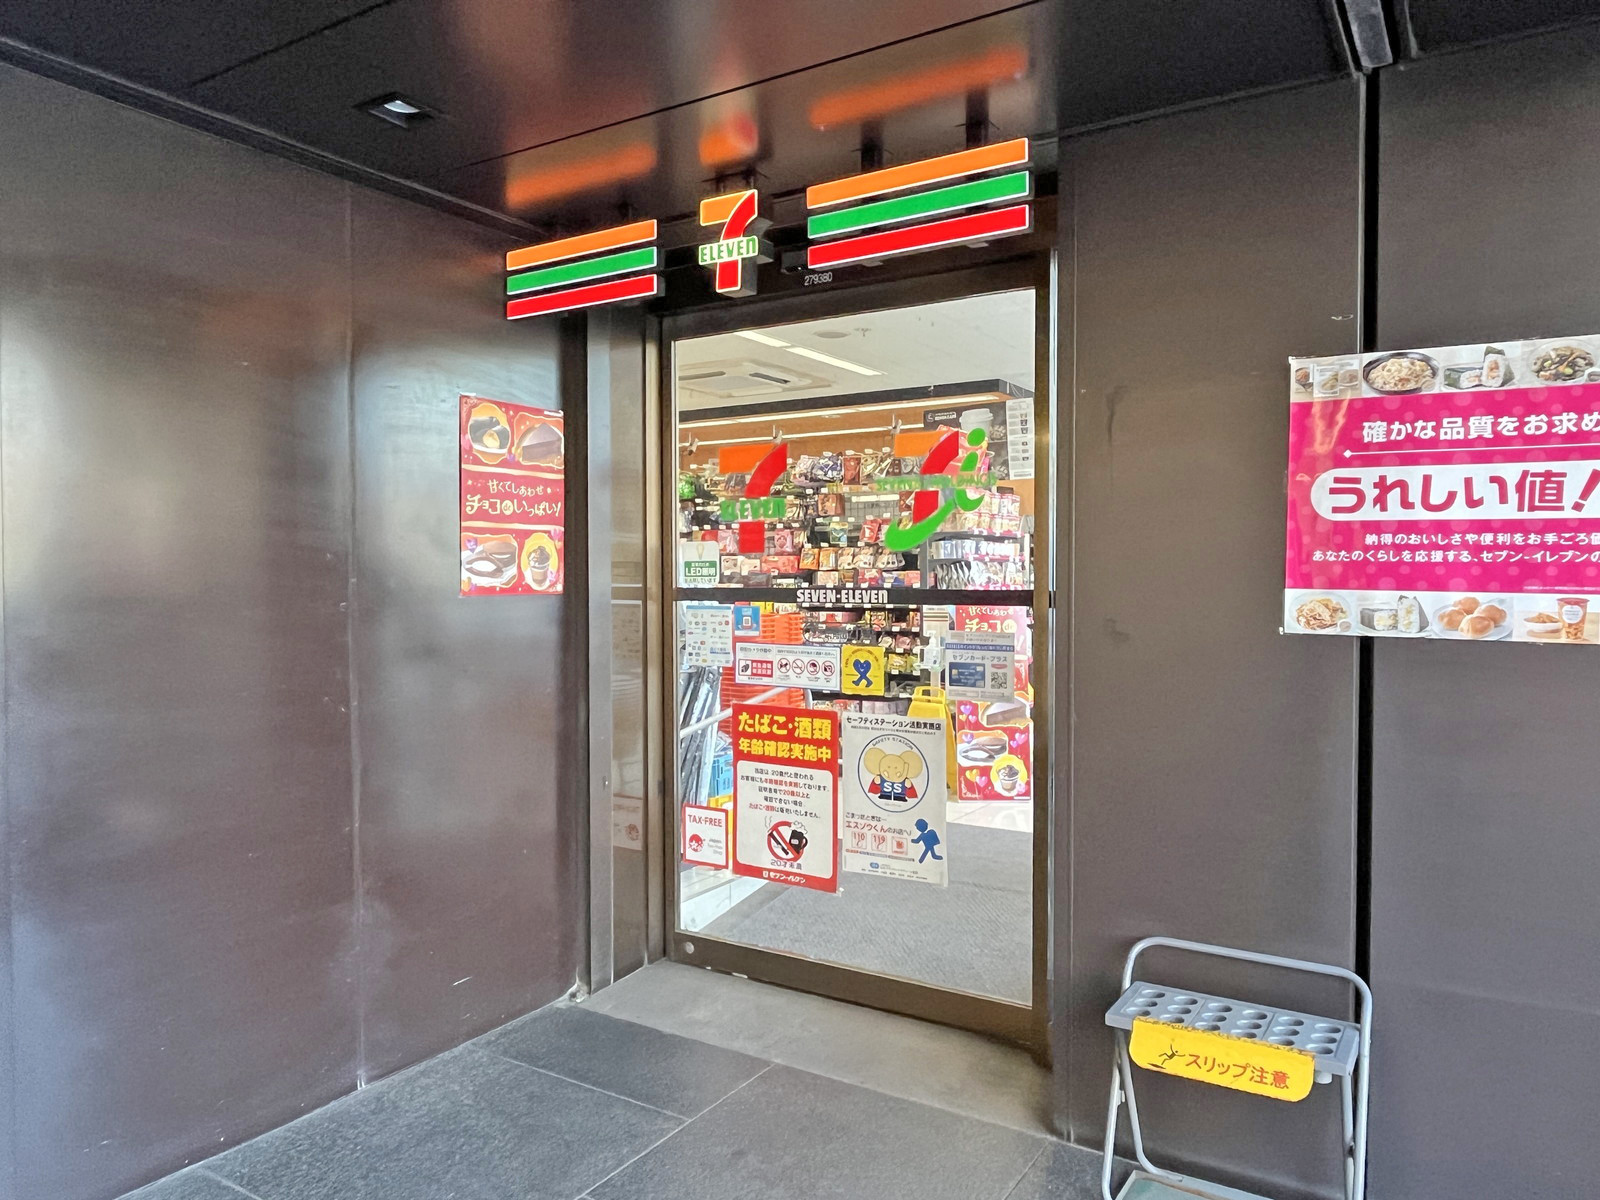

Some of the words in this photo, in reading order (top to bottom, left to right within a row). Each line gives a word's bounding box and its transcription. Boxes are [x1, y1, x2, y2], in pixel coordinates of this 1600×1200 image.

[804, 272, 833, 286] 279380
[1362, 412, 1600, 444] 確かな品質をお求め
[487, 479, 544, 497] 甘くてしあわせ
[738, 712, 832, 740] たばこ・酒類
[738, 737, 831, 762] 年齢確認実施中
[883, 781, 902, 793] SS
[687, 814, 723, 828] TAX-FREE
[1185, 1053, 1290, 1090] スリップ注意
